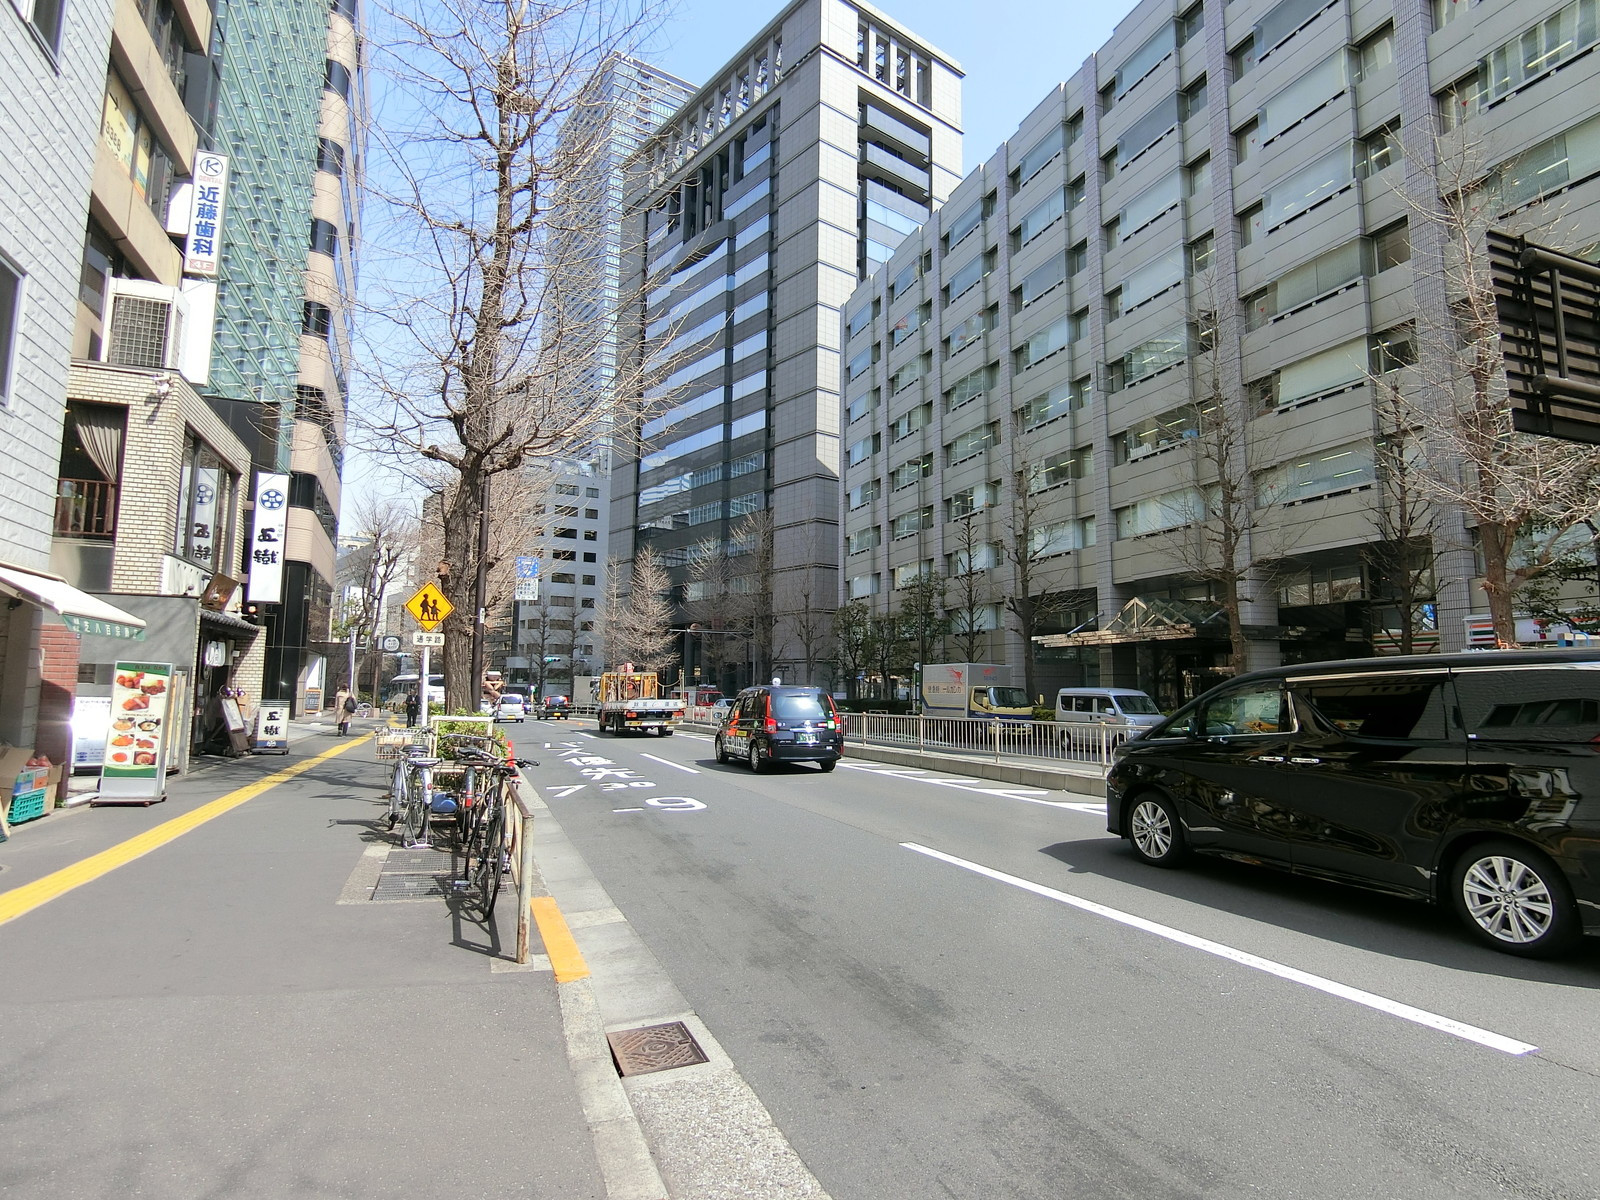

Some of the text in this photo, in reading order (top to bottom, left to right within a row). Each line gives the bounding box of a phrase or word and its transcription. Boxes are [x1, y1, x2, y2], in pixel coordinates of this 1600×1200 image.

[198, 175, 223, 184] DENTAL
[192, 185, 220, 257] 近藤歯科
[416, 634, 441, 644] 通学路
